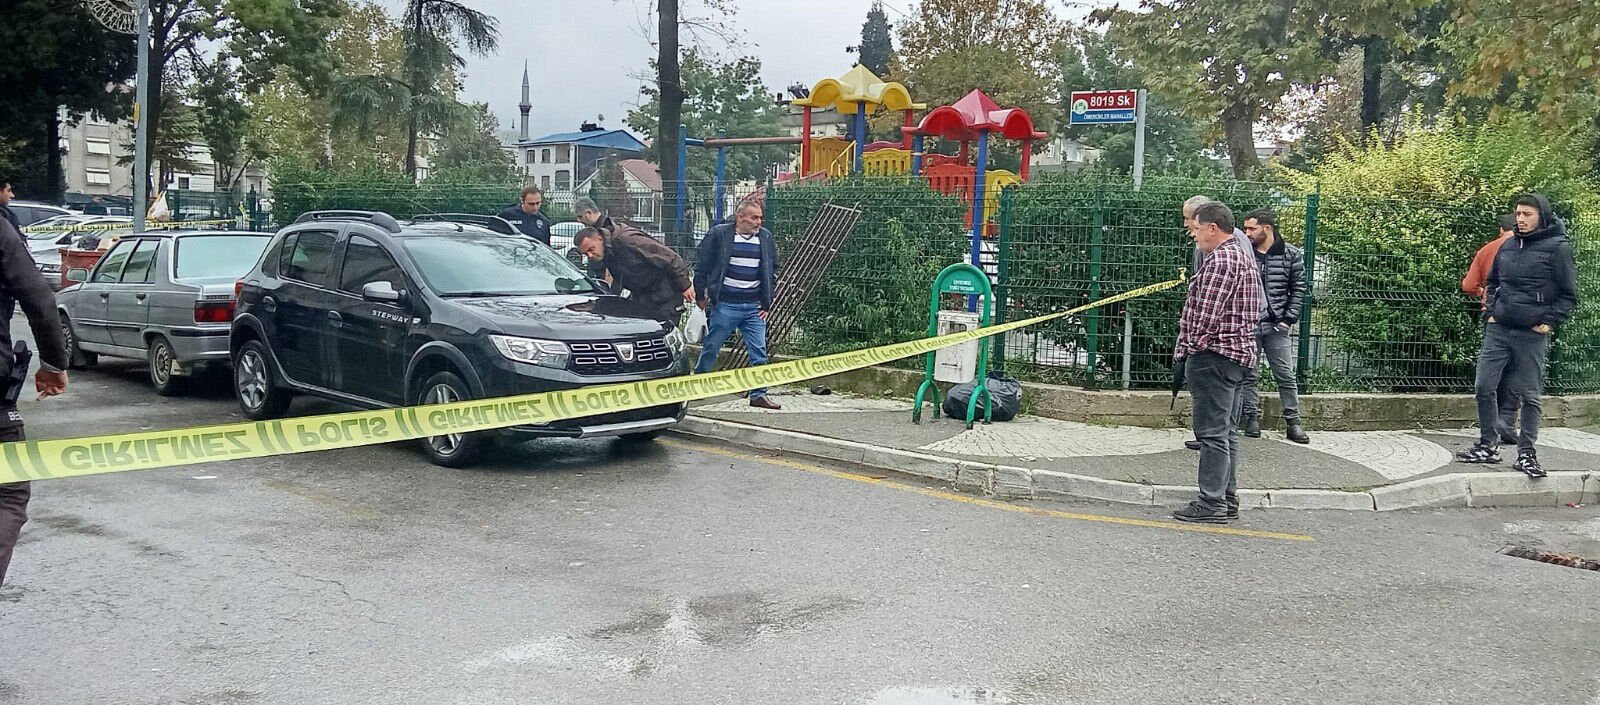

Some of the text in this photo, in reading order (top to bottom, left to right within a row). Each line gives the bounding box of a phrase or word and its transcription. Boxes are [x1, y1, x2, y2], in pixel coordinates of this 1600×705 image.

[1090, 95, 1131, 107] 8019 Sk
[372, 309, 408, 323] STEPWAY
